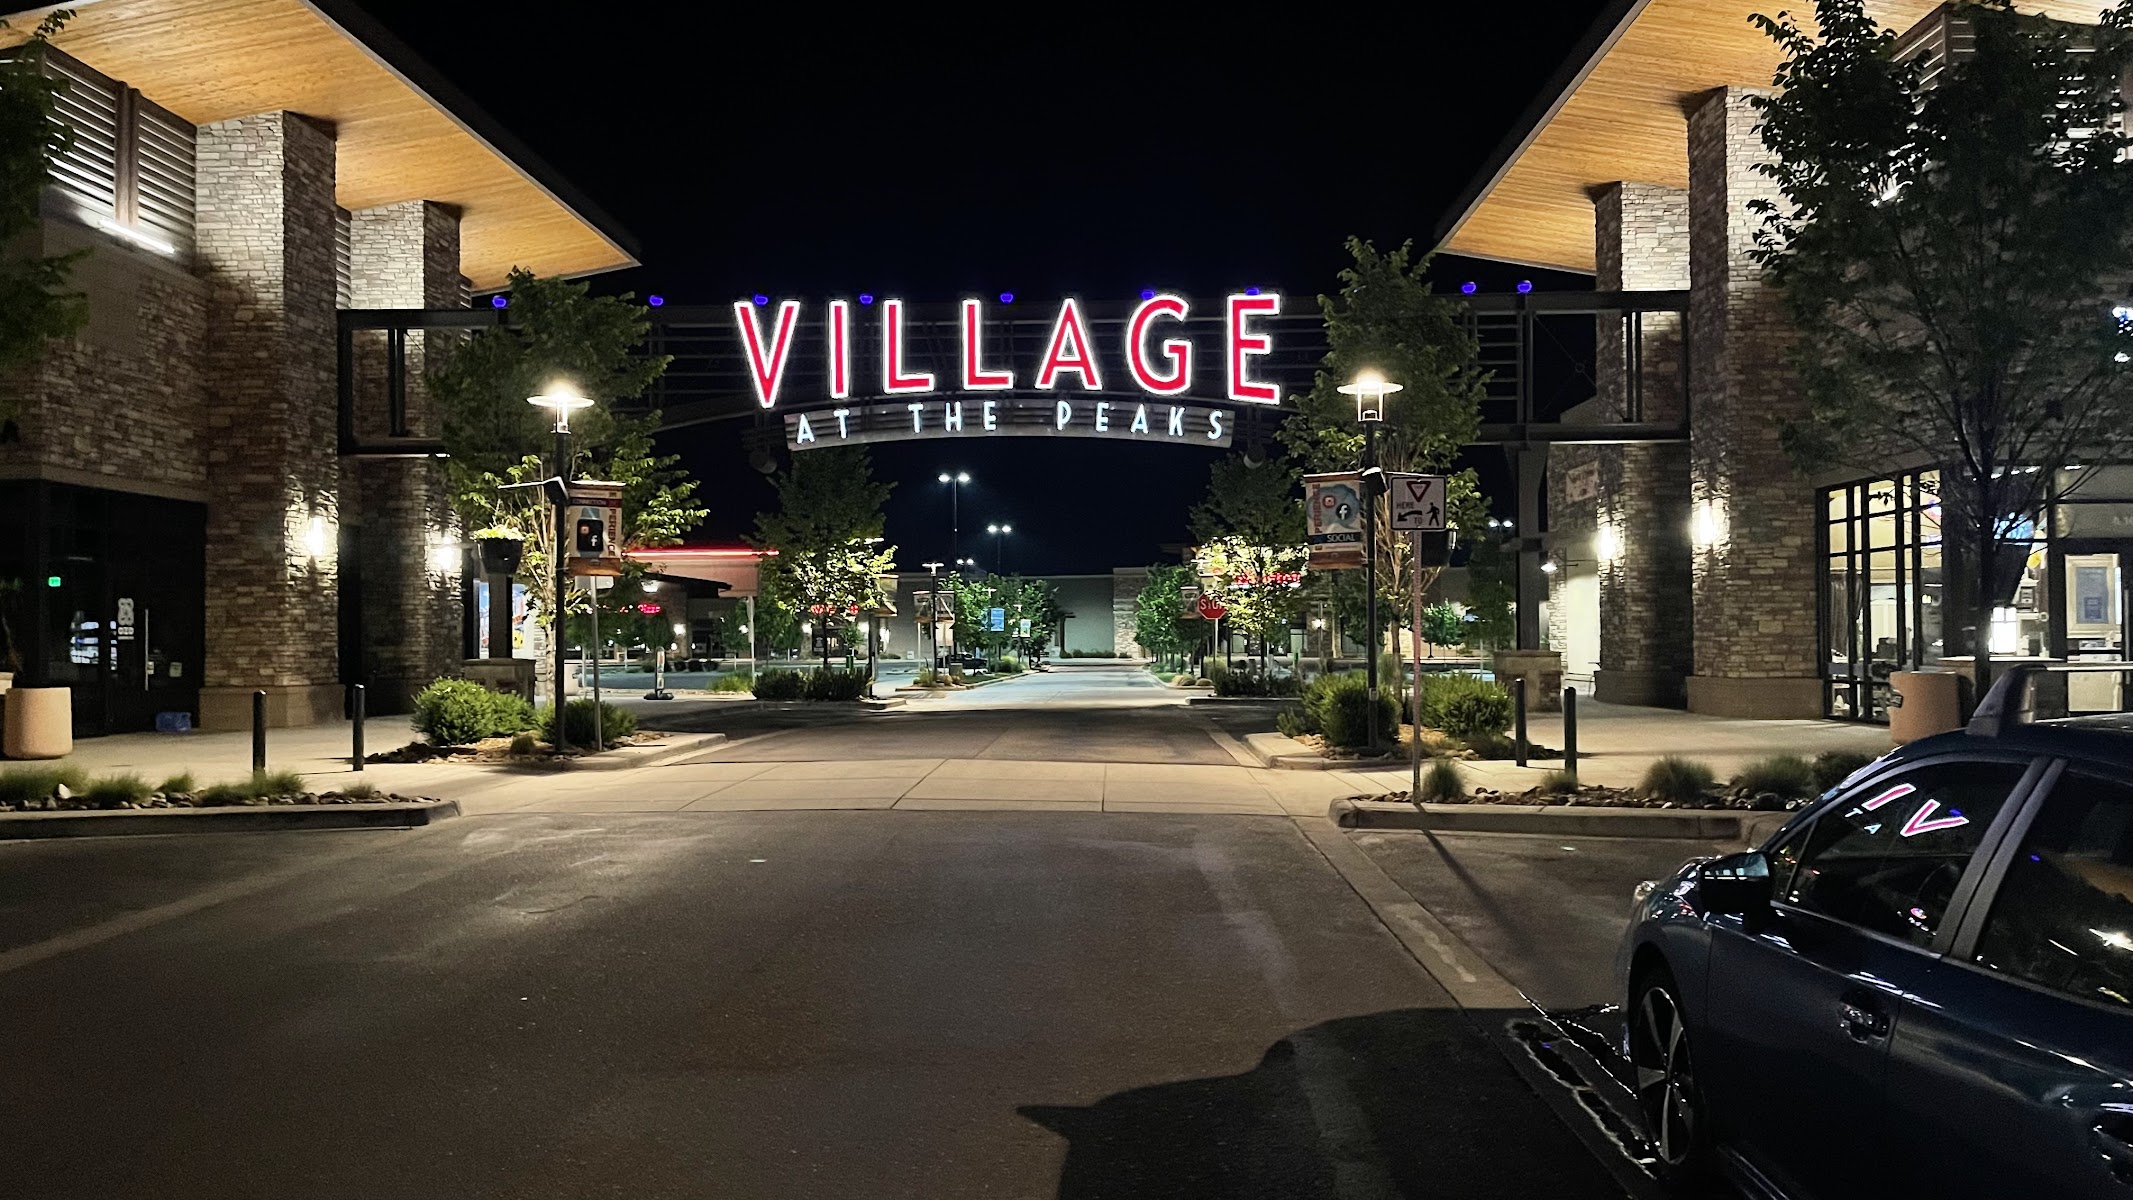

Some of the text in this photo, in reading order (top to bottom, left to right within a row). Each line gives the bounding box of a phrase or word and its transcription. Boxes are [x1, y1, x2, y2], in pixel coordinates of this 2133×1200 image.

[734, 293, 1281, 408] VILLAGE
[796, 401, 1224, 444] AT THE PEAKS
[1396, 501, 1414, 509] HERE
[1414, 516, 1423, 525] TO
[1327, 534, 1356, 542] SOCIAL
